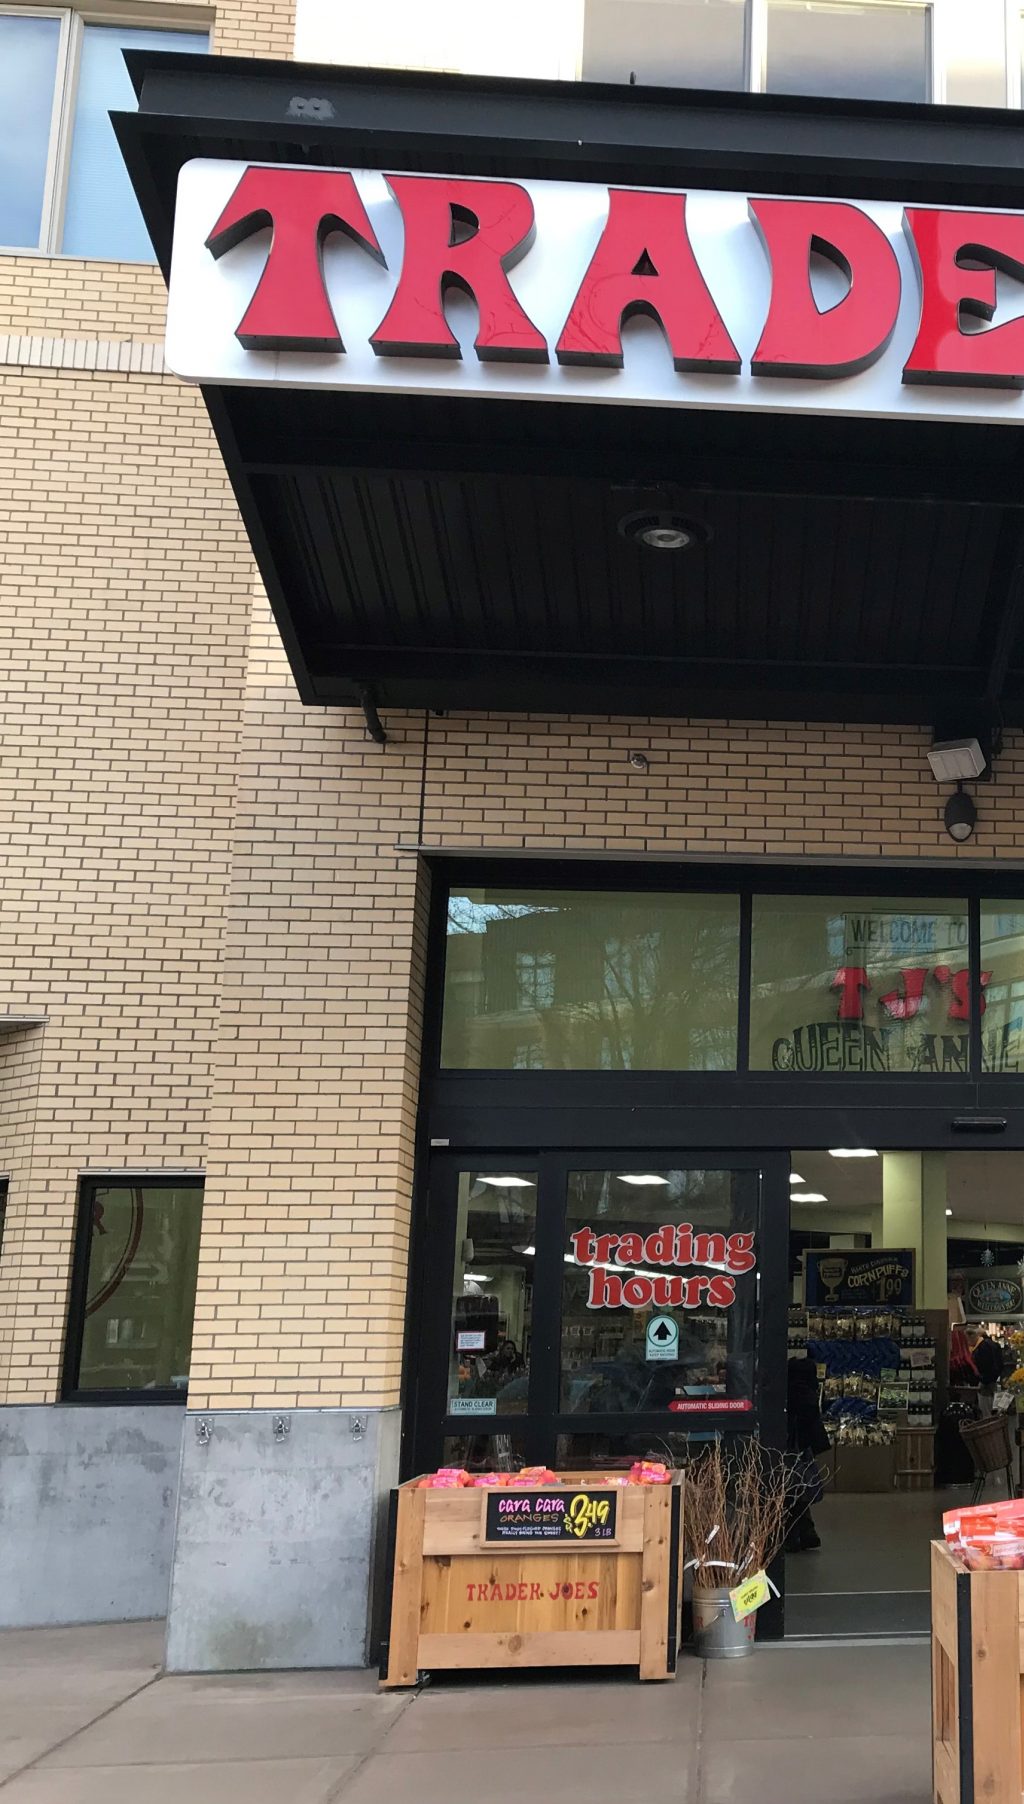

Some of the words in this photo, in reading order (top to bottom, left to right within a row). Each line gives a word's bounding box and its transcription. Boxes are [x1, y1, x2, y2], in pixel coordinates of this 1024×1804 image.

[851, 919, 936, 943] WELCOME
[944, 921, 967, 945] TO
[771, 1021, 893, 1071] QUEEN
[570, 1223, 756, 1275] trading
[586, 1267, 736, 1309] hours
[676, 1402, 707, 1410] AUTOMATIC
[707, 1402, 728, 1410] SLIDING
[729, 1401, 744, 1409] DOOR
[498, 1499, 531, 1513] cara
[535, 1498, 565, 1513] cara
[563, 1493, 611, 1538] $3.49
[499, 1513, 559, 1523] ORANGES
[594, 1527, 601, 1537] 3
[602, 1528, 612, 1537] LB
[466, 1582, 541, 1601] TRADER
[549, 1581, 600, 1601] JOES
